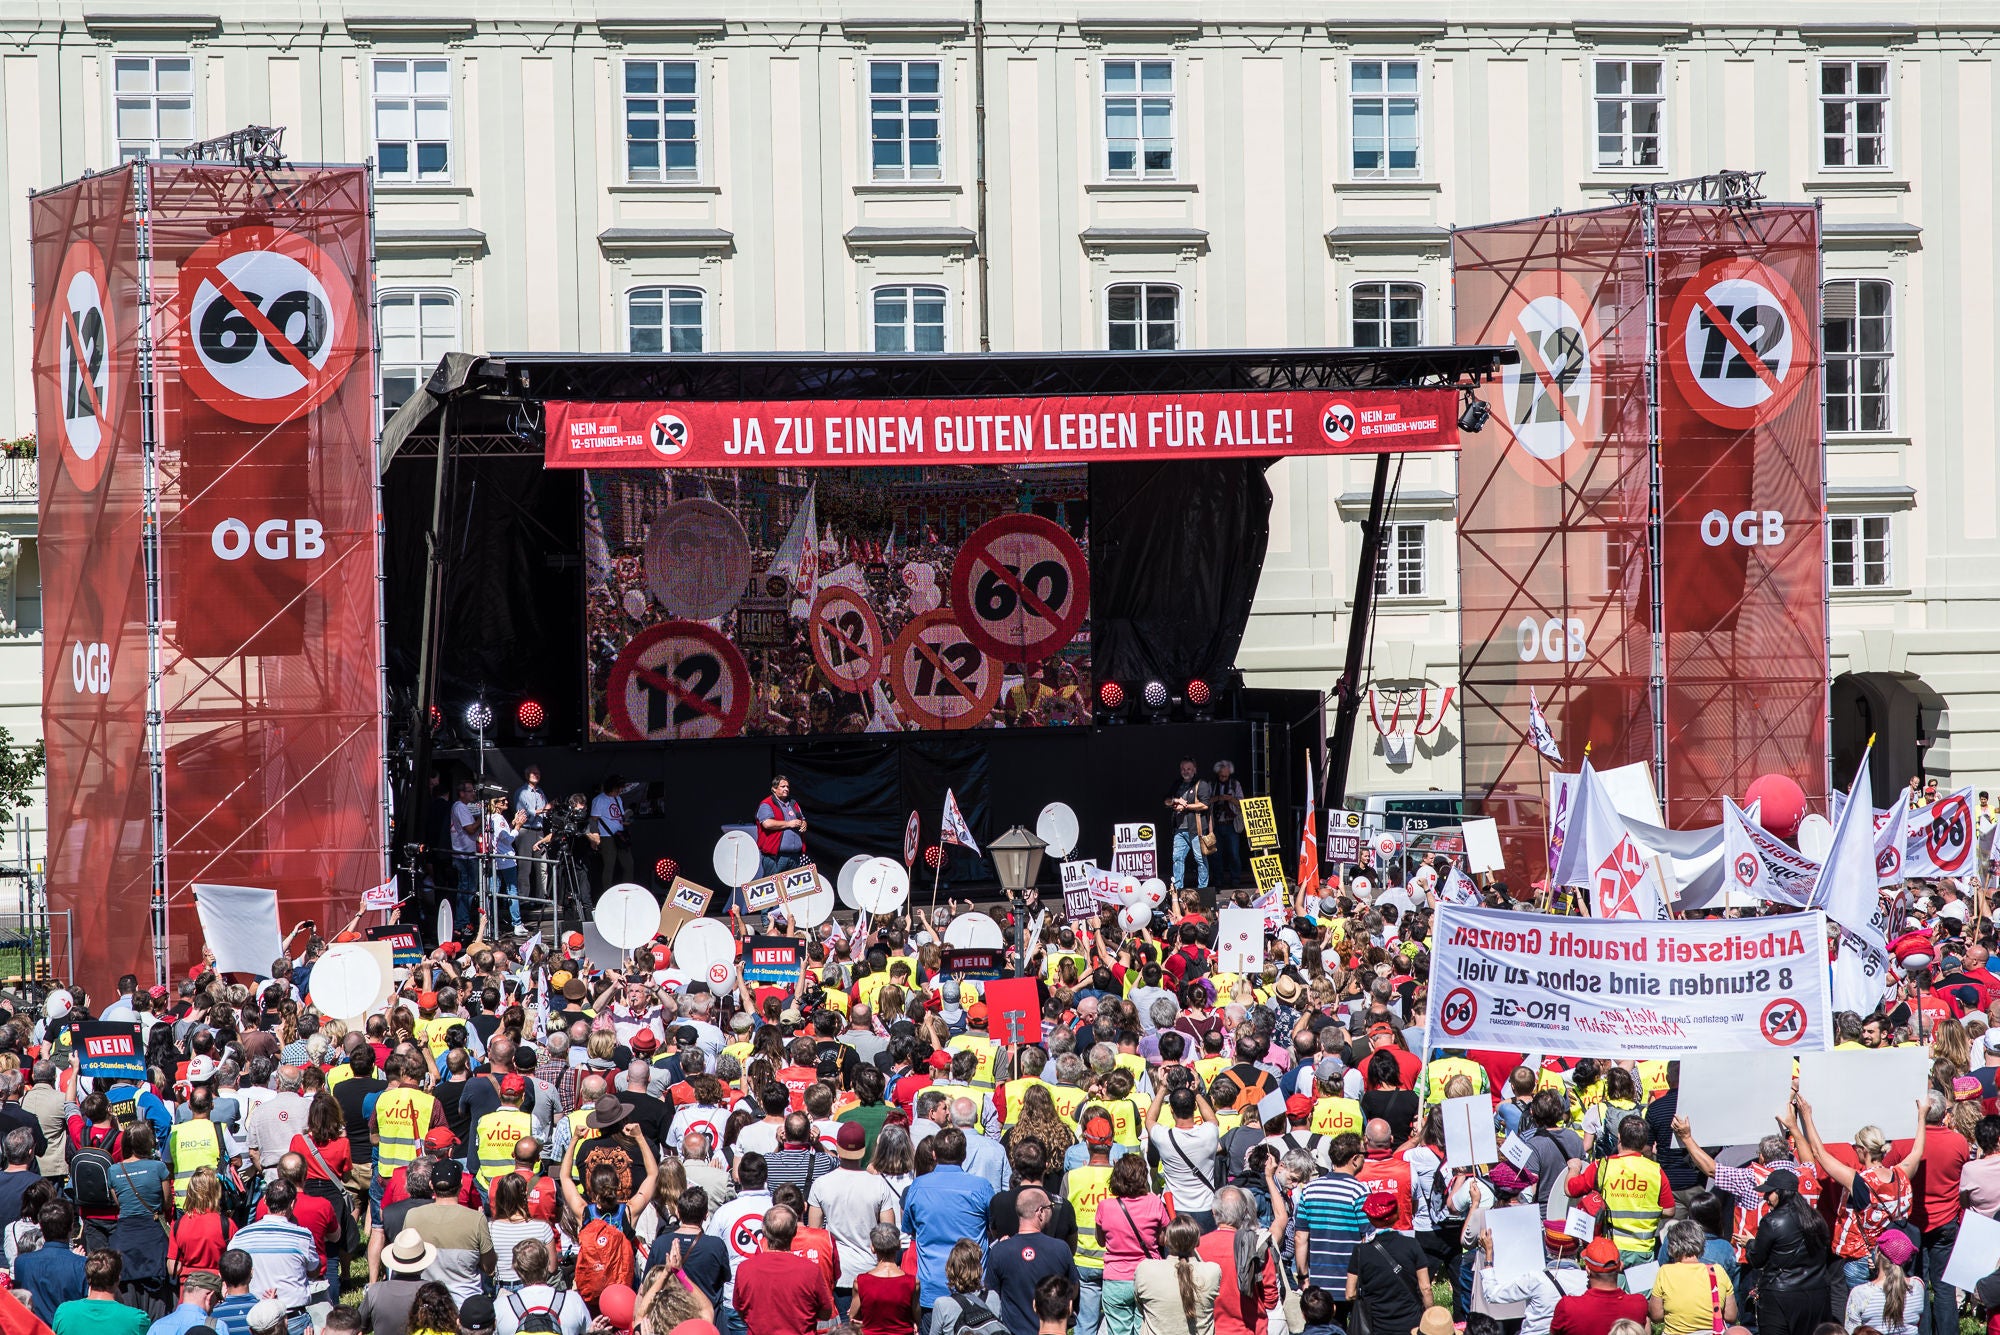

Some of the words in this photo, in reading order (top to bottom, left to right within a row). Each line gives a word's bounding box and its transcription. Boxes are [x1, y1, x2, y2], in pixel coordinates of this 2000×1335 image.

[199, 289, 328, 365] 60
[1698, 304, 1786, 380] 12
[65, 306, 105, 421] 12
[1514, 326, 1583, 427] 12
[1325, 413, 1354, 434] 60
[1360, 410, 1383, 423] NEIN
[1383, 412, 1397, 421] zur
[570, 422, 597, 436] NEIN
[598, 425, 618, 435] zum
[655, 422, 686, 446] 12
[723, 417, 766, 456] JA
[774, 416, 814, 455] ZU
[826, 415, 924, 454] EINEM
[934, 412, 1033, 453] GUTEN
[1043, 411, 1138, 450] LEBEN
[1148, 403, 1206, 448] FÜR
[1213, 407, 1294, 446] ALLE!
[1360, 419, 1437, 436] 60-STUNDEN-WOCHE
[570, 434, 643, 450] 12-STUNDEN-TAG
[974, 560, 1069, 622] 60
[820, 610, 869, 668] 12
[914, 641, 983, 697] 12
[636, 652, 723, 734] 12
[1243, 799, 1269, 811] LASST
[1245, 809, 1271, 820] NAZIS
[1248, 818, 1273, 829] NICHT
[1329, 813, 1341, 828] JA
[1117, 827, 1132, 844] JA
[1249, 827, 1274, 836] REGIEREN
[1329, 836, 1350, 854] NEIN
[1118, 853, 1144, 871] NEIN
[1254, 857, 1279, 870] LASST
[1063, 865, 1077, 883] JA
[1256, 867, 1282, 879] NAZIS
[1088, 876, 1119, 893] vida
[1066, 890, 1090, 910] NEIN
[382, 936, 414, 948] EIN
[754, 949, 794, 963] NEIN
[953, 956, 990, 968] NEIN
[752, 968, 801, 977] 60-Stunden-Woch
[87, 1036, 133, 1055] NEIN
[89, 1061, 145, 1072] 60-Stunden-Woche
[385, 1099, 420, 1120] vida
[1318, 1109, 1354, 1129] vida
[486, 1121, 522, 1141] vida
[1609, 1169, 1648, 1192] vida
